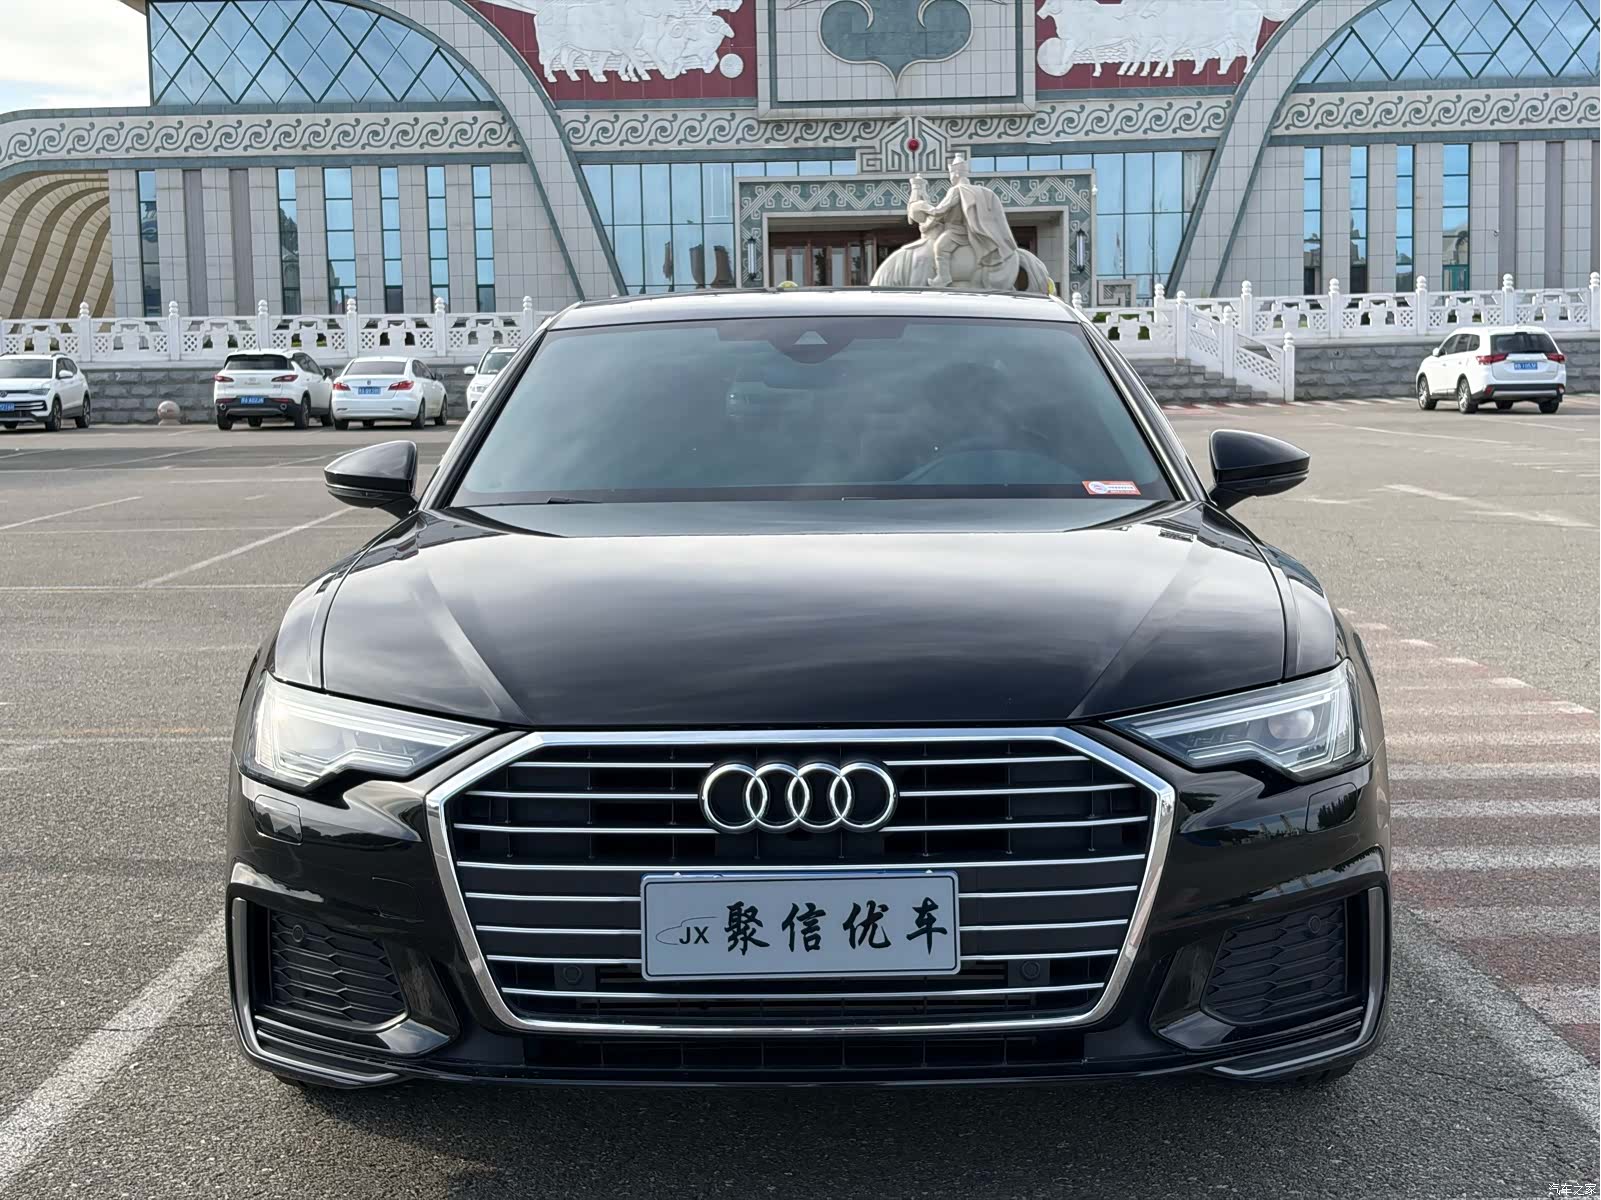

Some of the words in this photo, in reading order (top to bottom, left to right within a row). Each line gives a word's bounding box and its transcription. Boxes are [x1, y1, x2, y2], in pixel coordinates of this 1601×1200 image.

[679, 926, 710, 945] JX
[724, 896, 948, 955] 聚信优车
